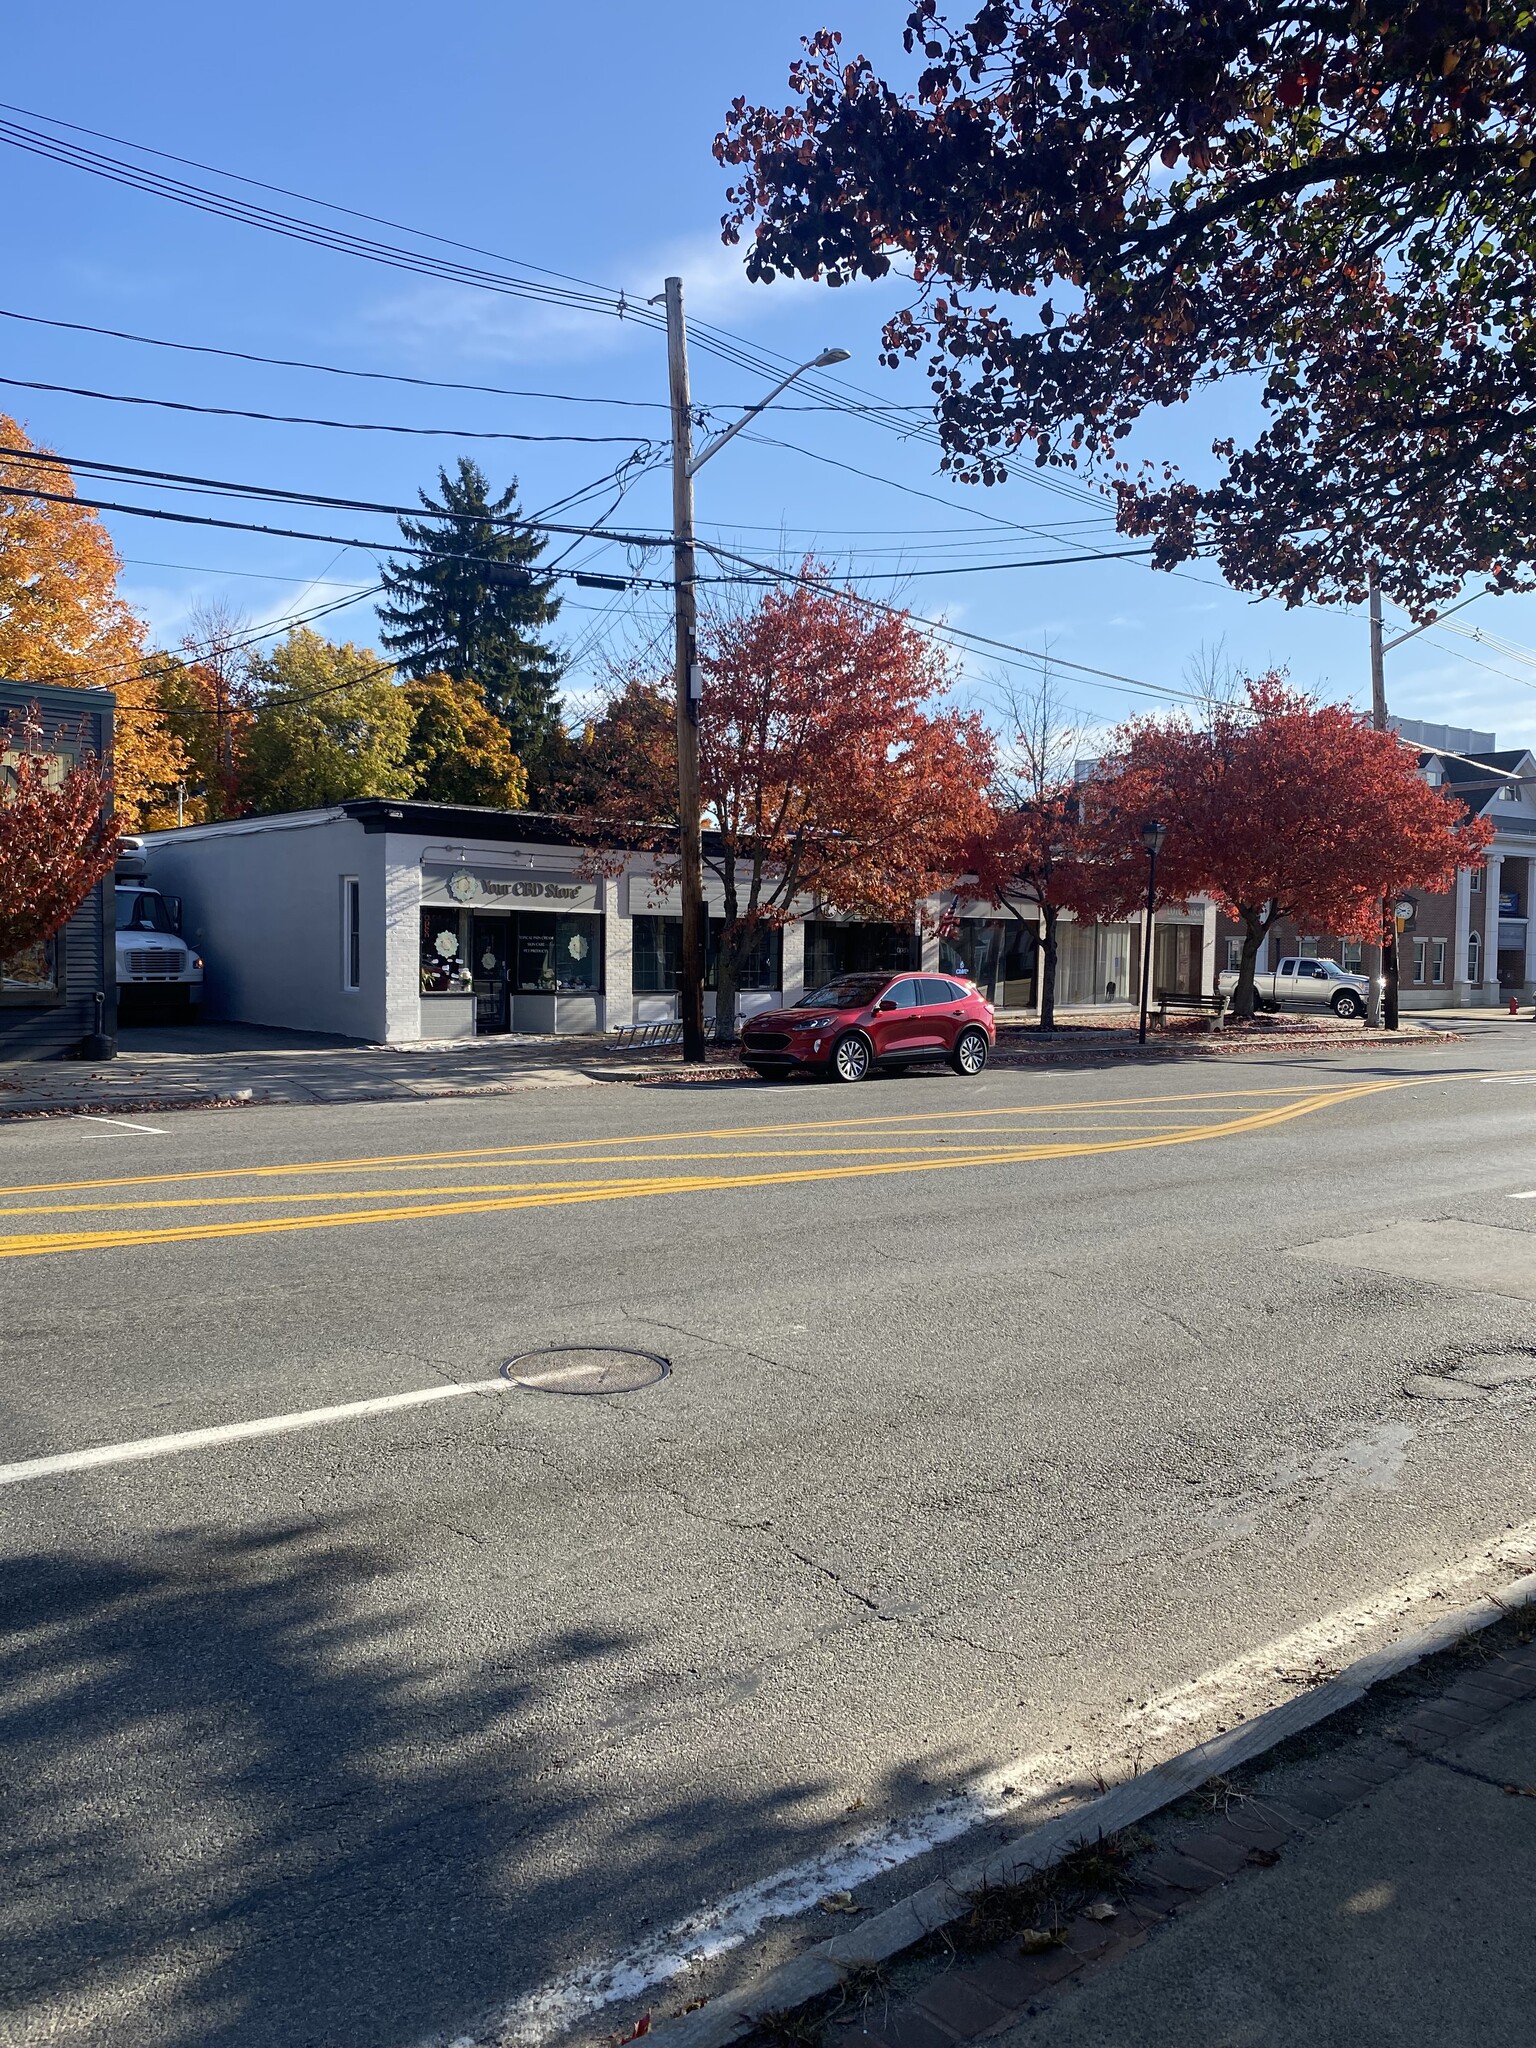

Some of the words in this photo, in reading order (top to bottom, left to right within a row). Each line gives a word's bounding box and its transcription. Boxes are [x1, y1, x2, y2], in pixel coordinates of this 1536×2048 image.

[481, 879, 512, 896] Your
[512, 881, 544, 898] CBD
[544, 883, 582, 899] Store
